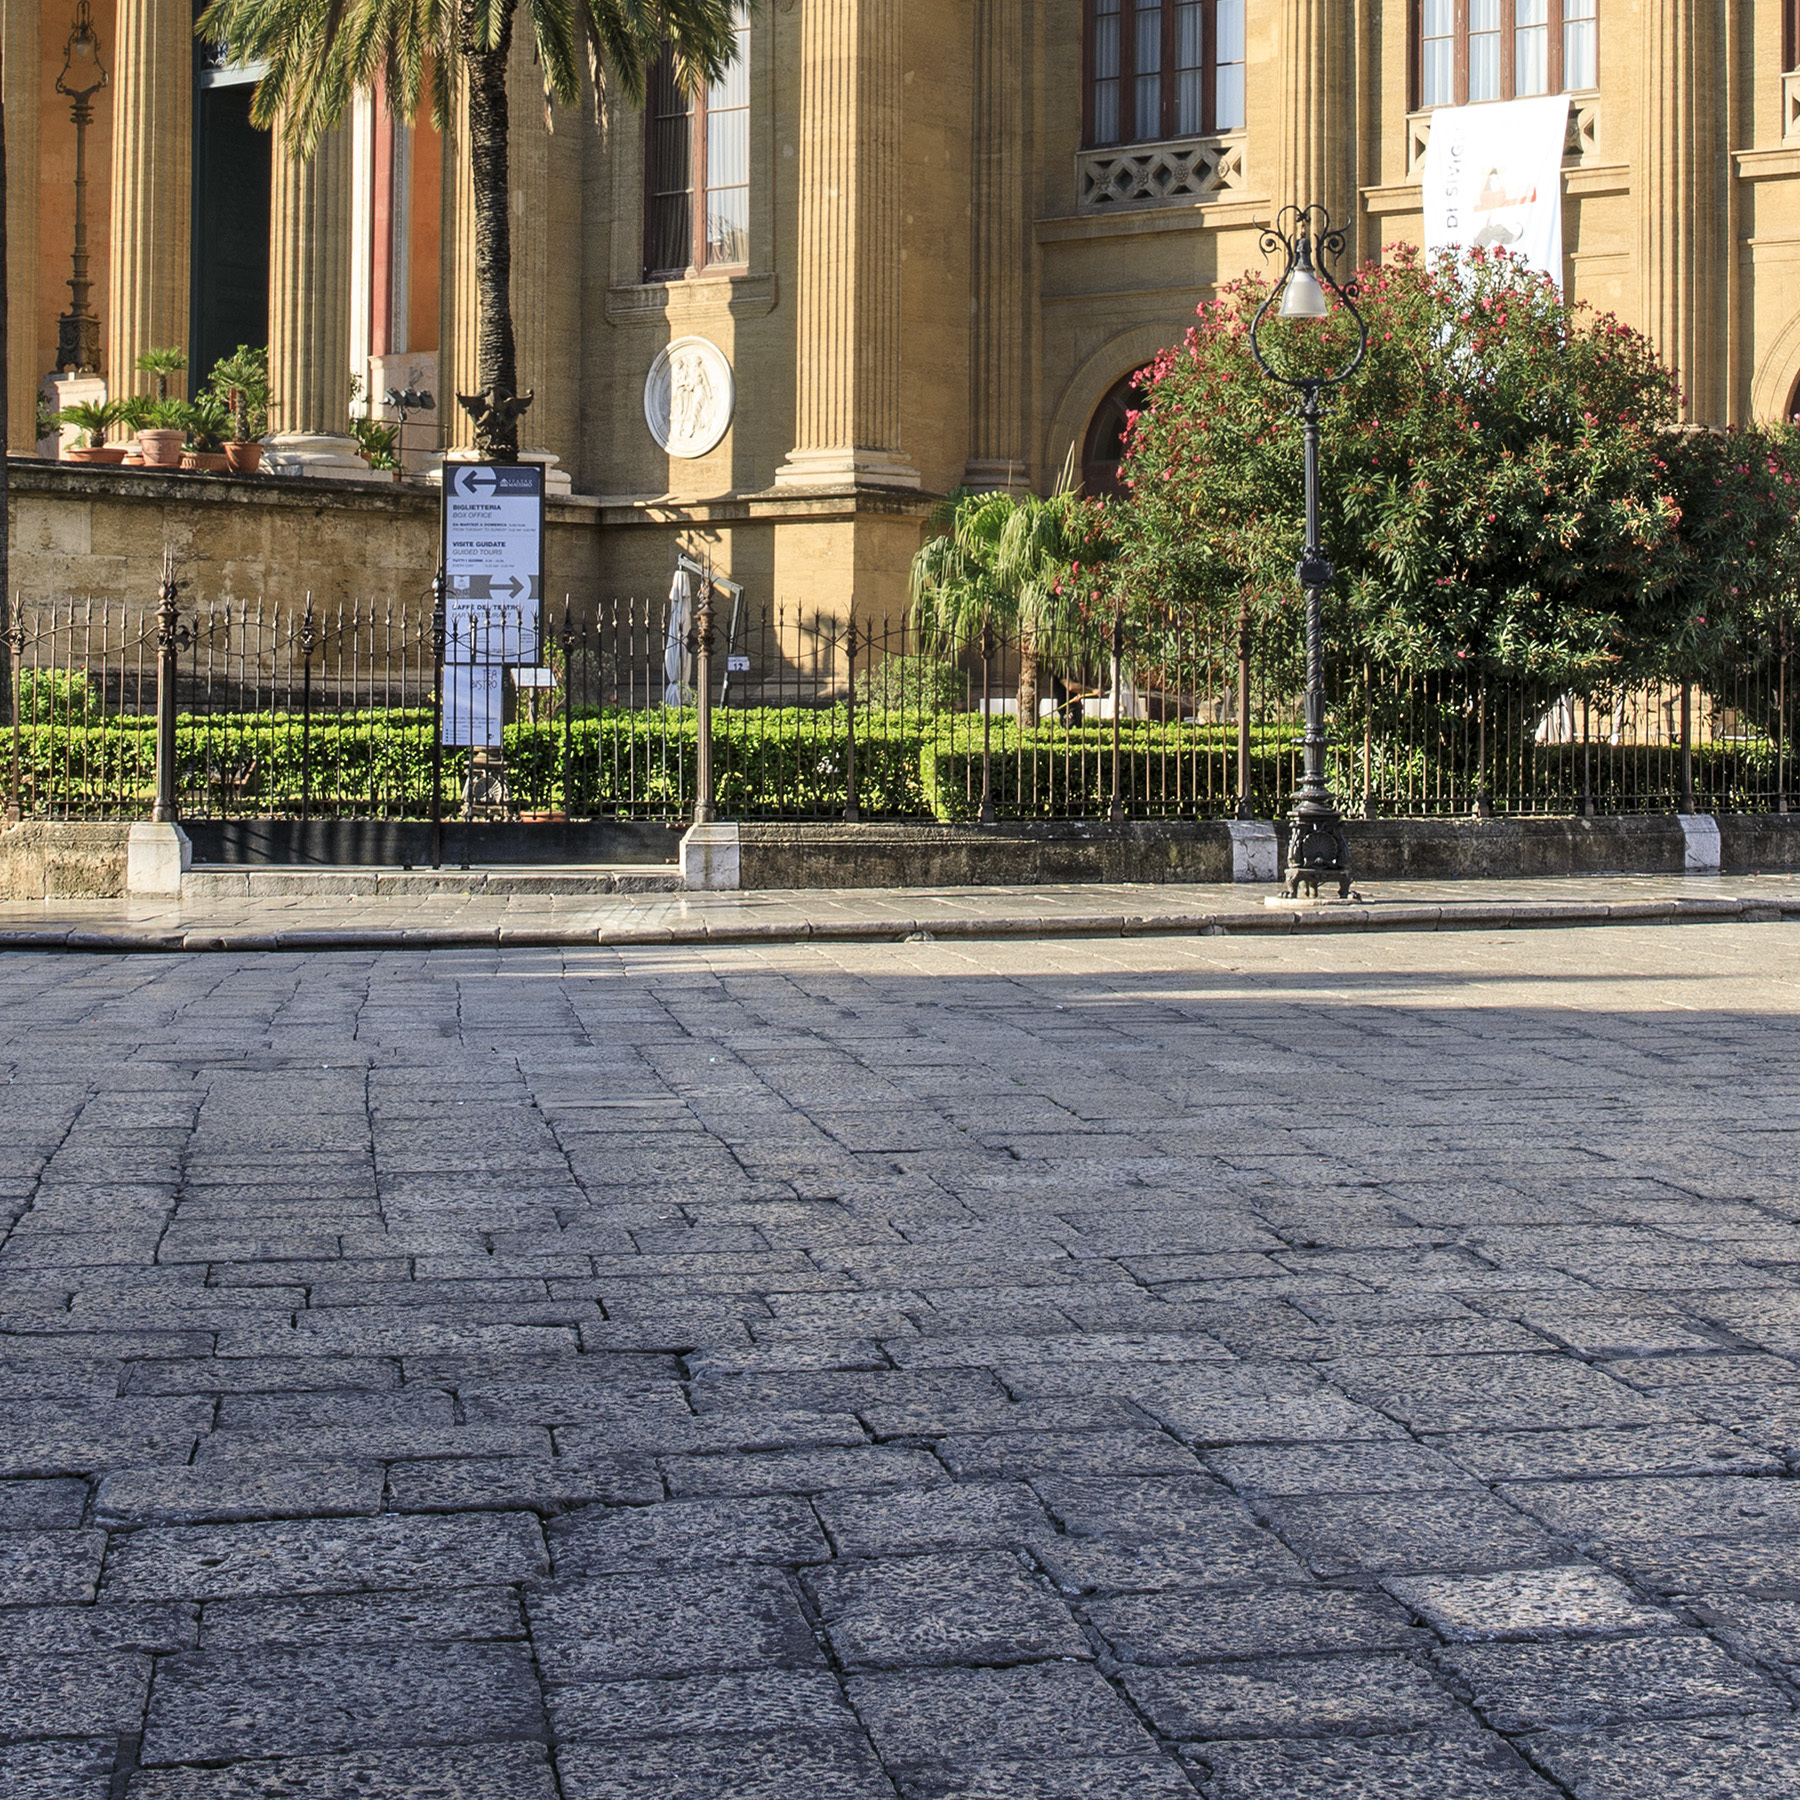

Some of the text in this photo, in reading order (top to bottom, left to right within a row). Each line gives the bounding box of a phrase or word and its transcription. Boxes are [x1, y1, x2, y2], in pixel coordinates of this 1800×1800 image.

[1445, 127, 1465, 229] DI SIVIG
[733, 662, 744, 671] 12
[483, 669, 497, 680] TEA
